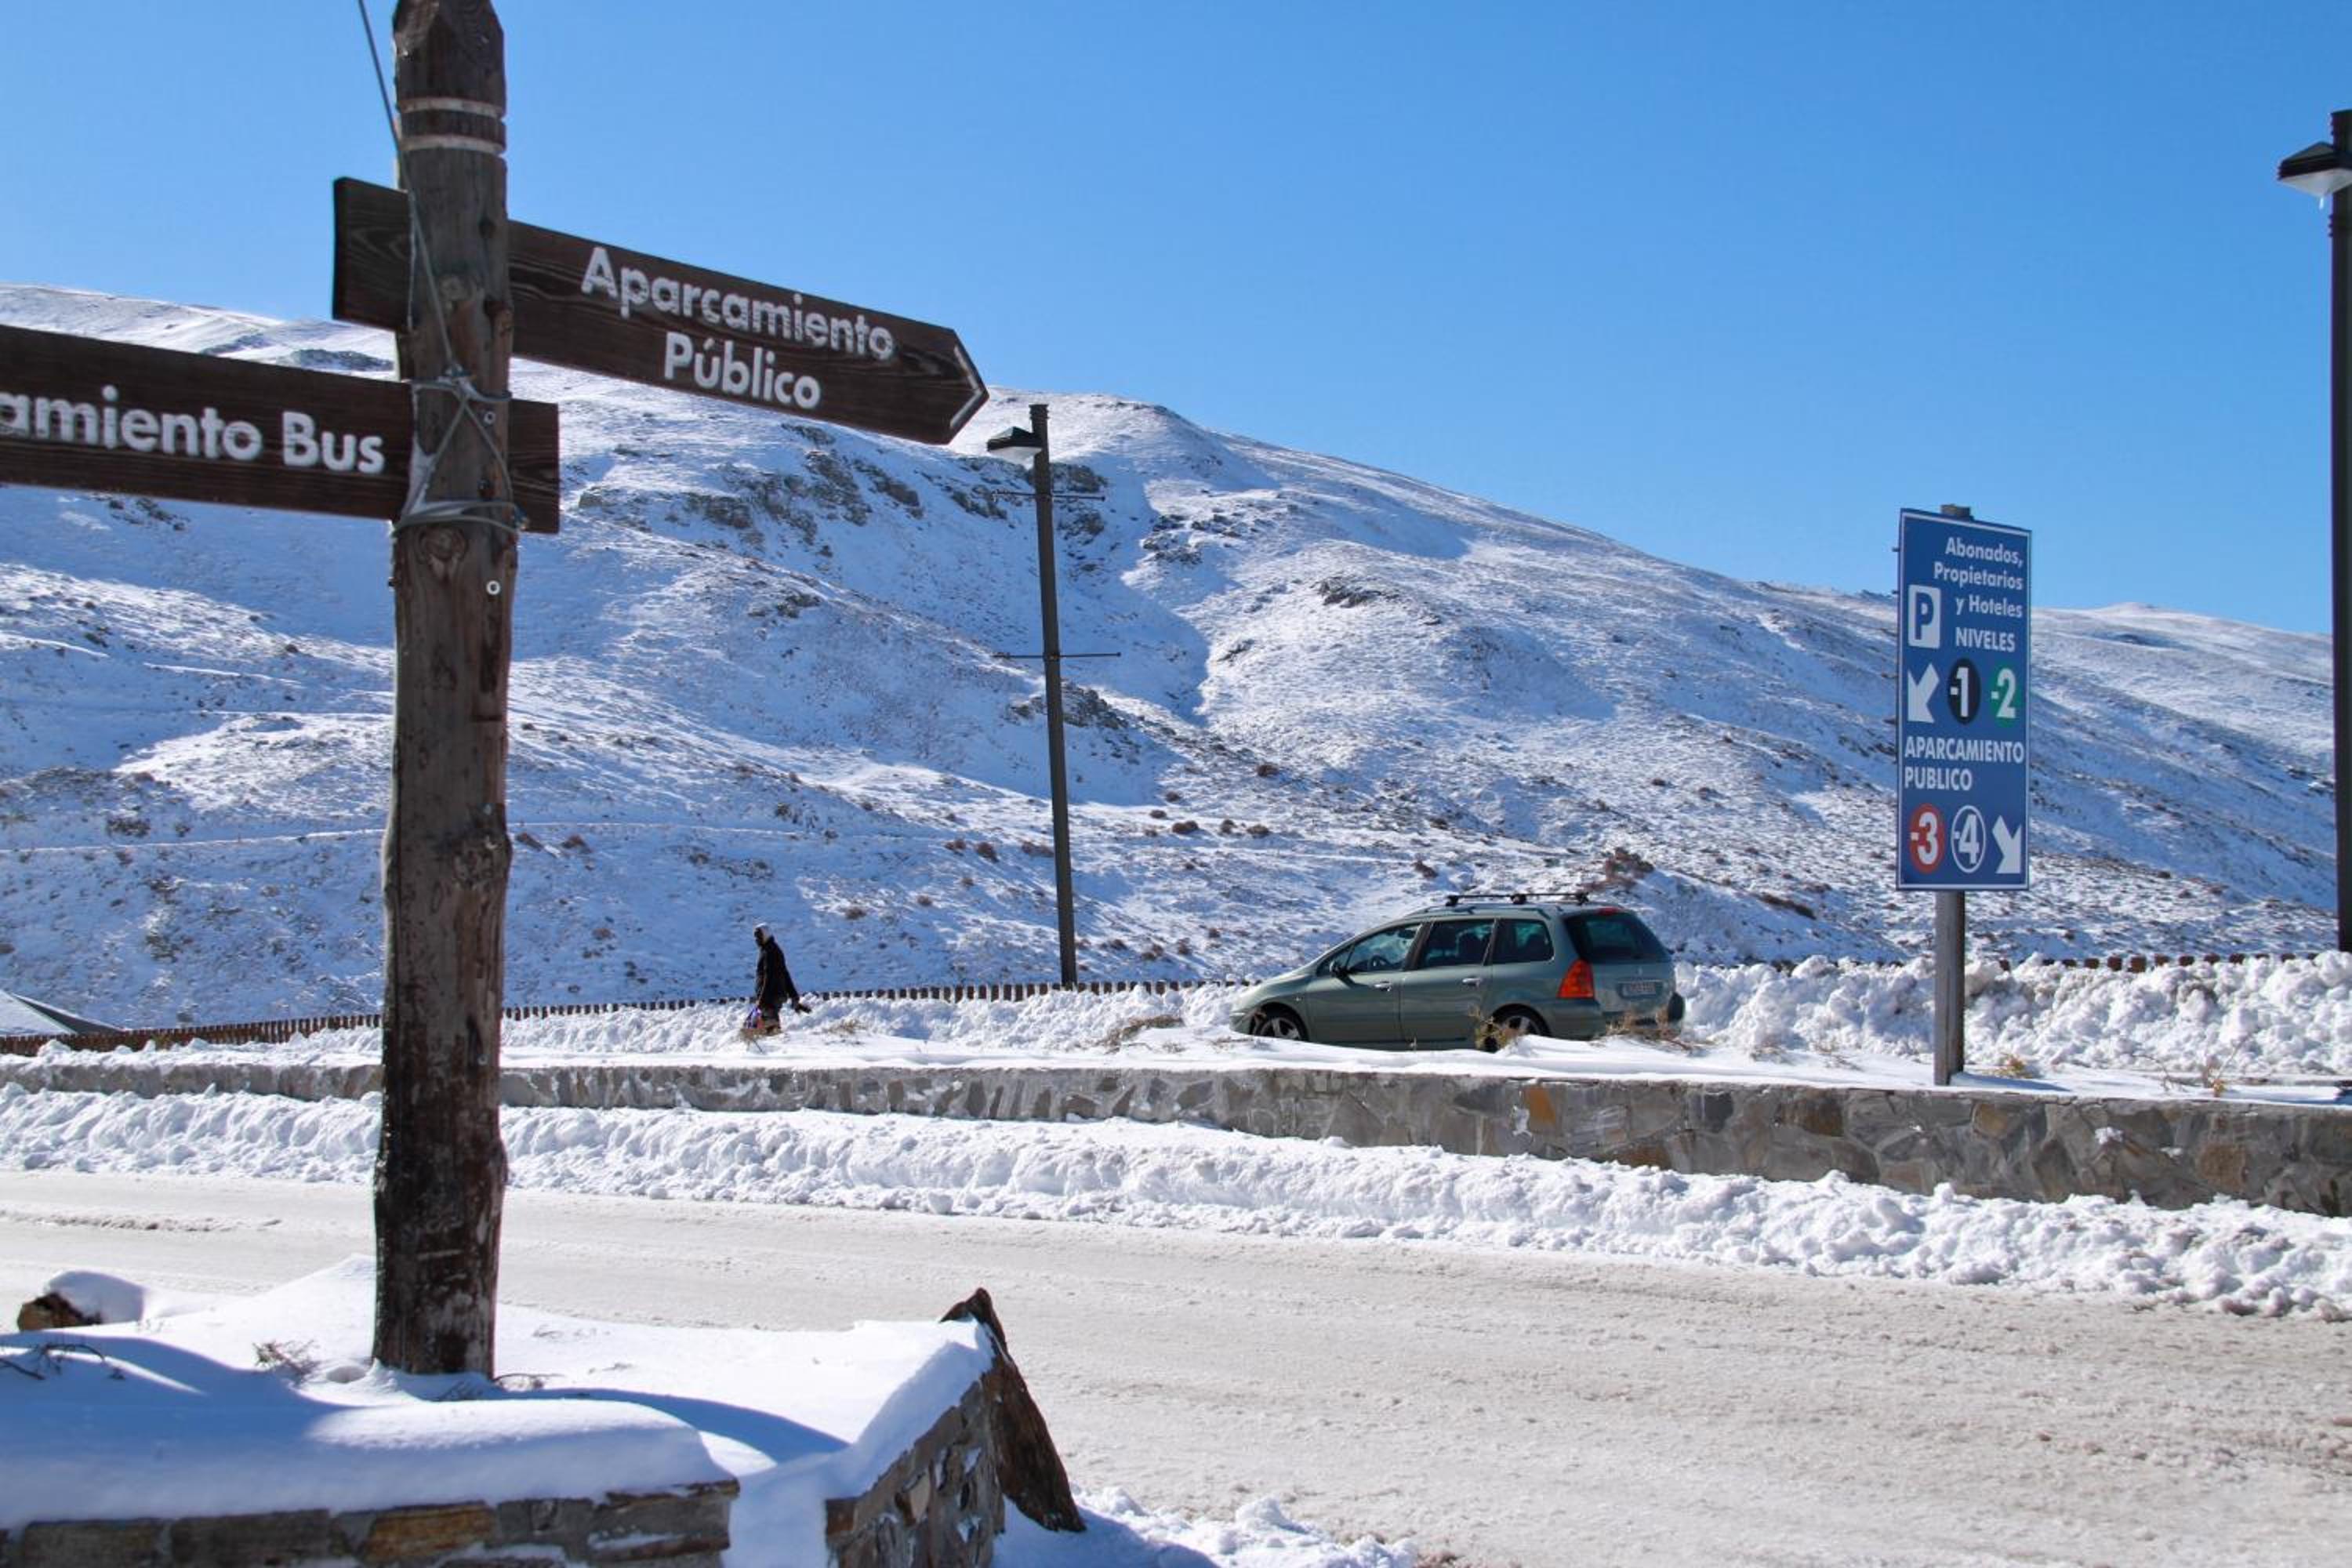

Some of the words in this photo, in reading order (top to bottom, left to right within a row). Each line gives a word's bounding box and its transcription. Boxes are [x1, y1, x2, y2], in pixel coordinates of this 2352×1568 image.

[580, 246, 895, 361] Aparcamiento
[663, 332, 821, 410] Público
[281, 411, 385, 474] Bus
[1945, 537, 2024, 568] Abonados,
[1933, 561, 2024, 590] Propietarios
[1956, 597, 1965, 615] y
[1969, 593, 2024, 618] Hoteles
[1955, 627, 2016, 652] NIVELES
[1904, 736, 2024, 764] APARCAMIENTO
[1904, 766, 1973, 791] PUBLICO
